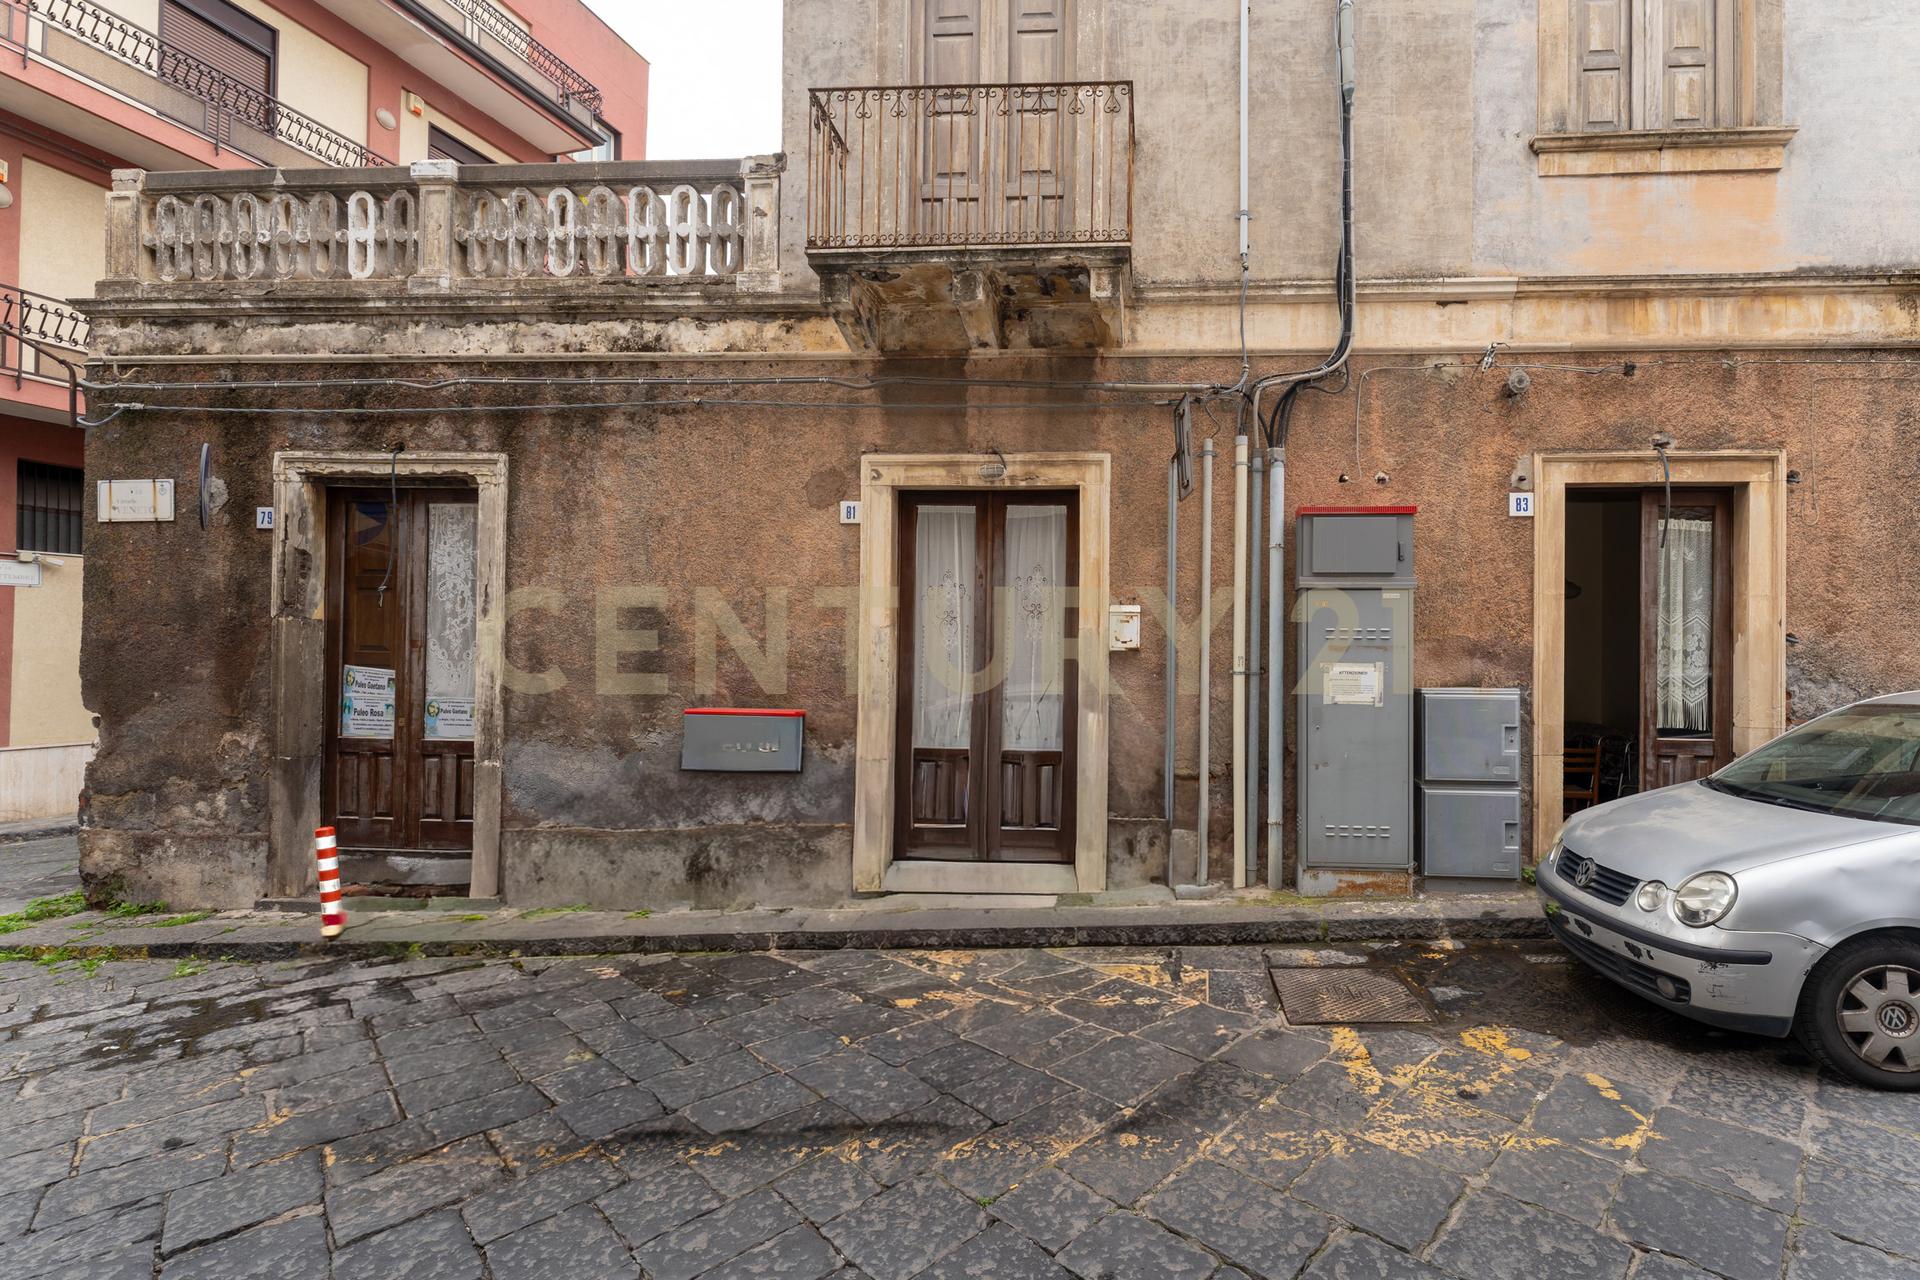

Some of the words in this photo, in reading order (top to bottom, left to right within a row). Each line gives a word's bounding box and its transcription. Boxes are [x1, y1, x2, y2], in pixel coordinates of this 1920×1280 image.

[1515, 497, 1529, 512] 83
[260, 511, 273, 525] 79
[846, 505, 856, 520] 81
[370, 708, 384, 718] Rosa
